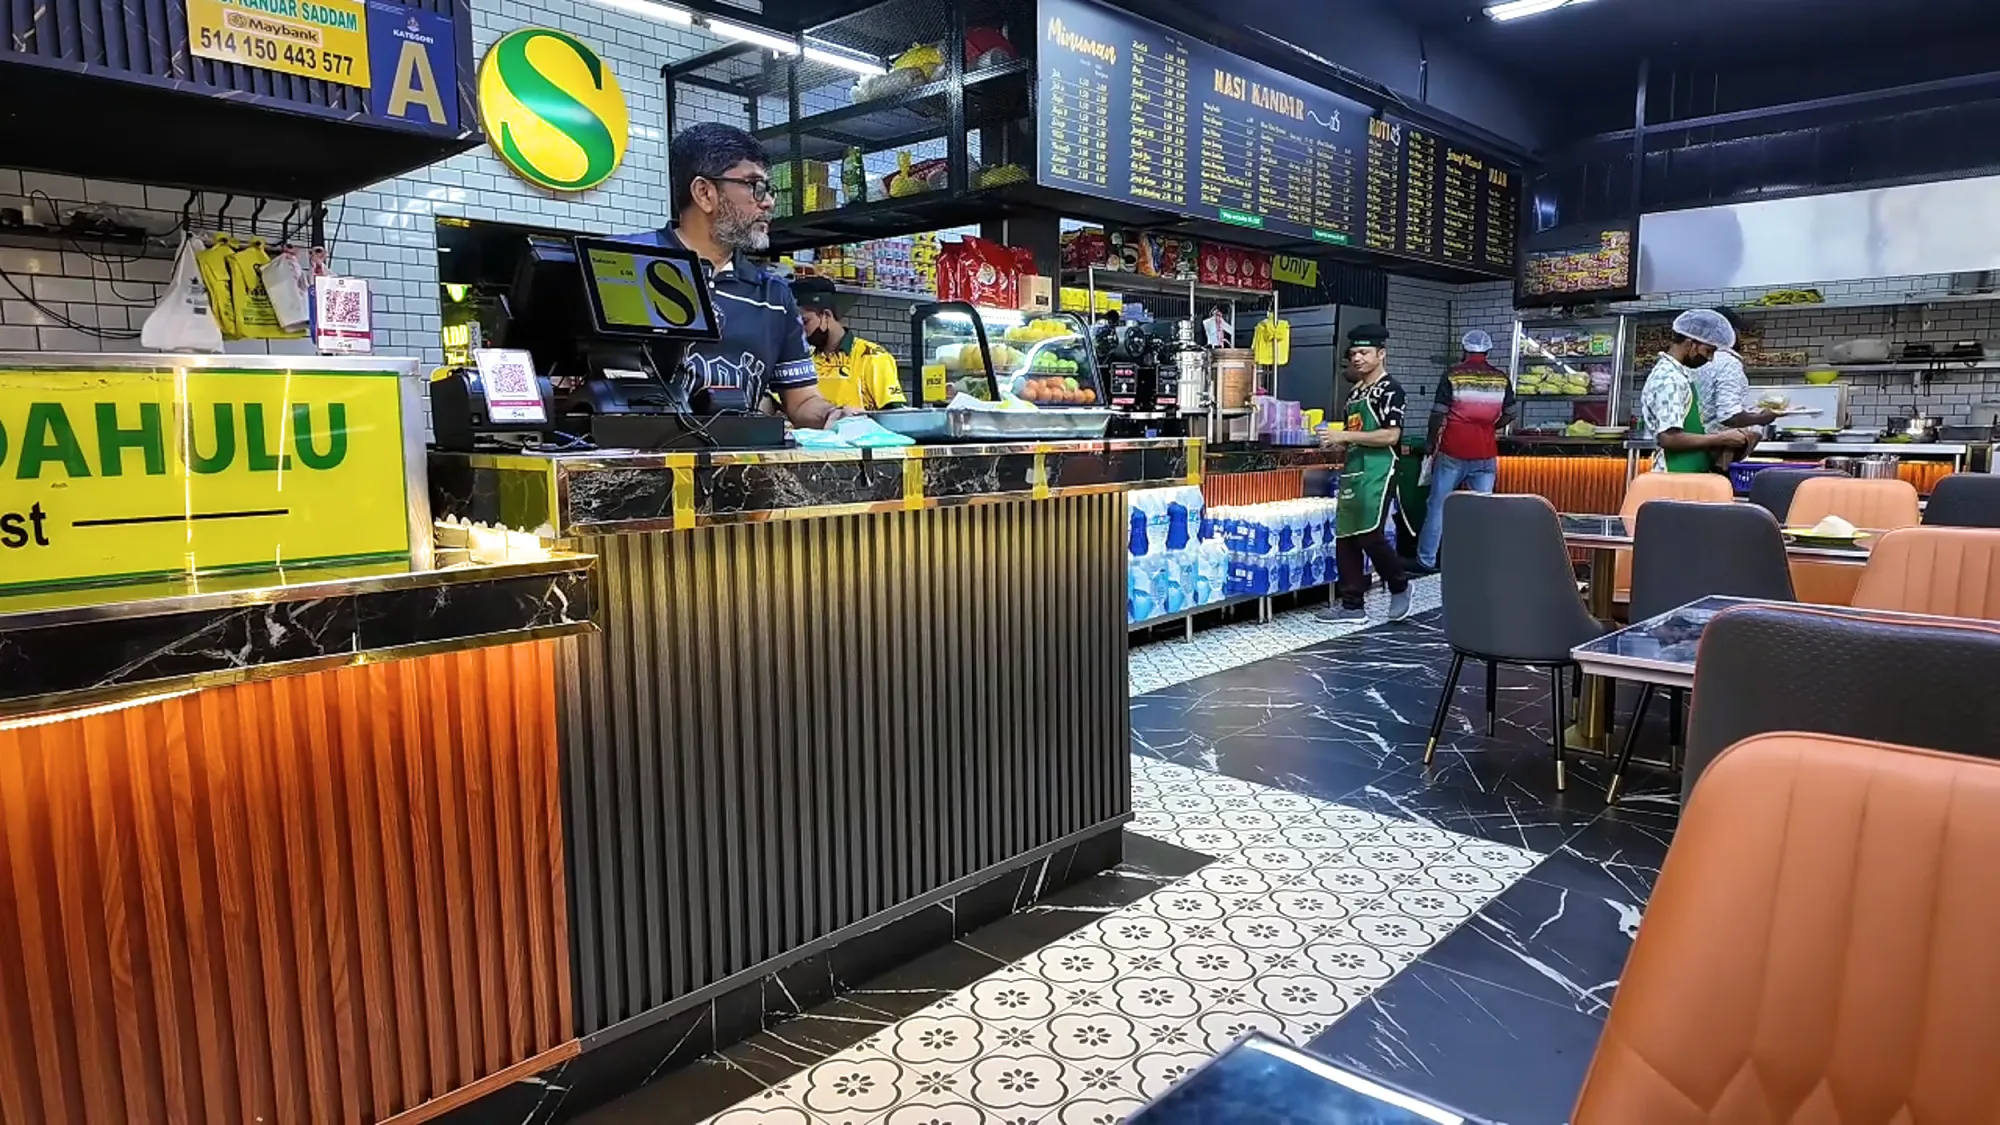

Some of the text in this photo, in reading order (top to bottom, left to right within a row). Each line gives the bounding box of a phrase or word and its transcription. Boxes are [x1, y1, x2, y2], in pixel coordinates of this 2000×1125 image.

[249, 19, 318, 43] Maybank
[302, 3, 358, 31] SADDAM
[392, 29, 434, 45] KATEGORI
[1047, 16, 1117, 65] Minuman
[201, 26, 353, 76] 514 150 443 577
[387, 39, 448, 126] A
[1213, 68, 1305, 121] NASI KANDAR
[496, 29, 616, 189] S
[1279, 254, 1311, 280] Only
[644, 259, 696, 327] S
[0, 402, 348, 480] AHULU
